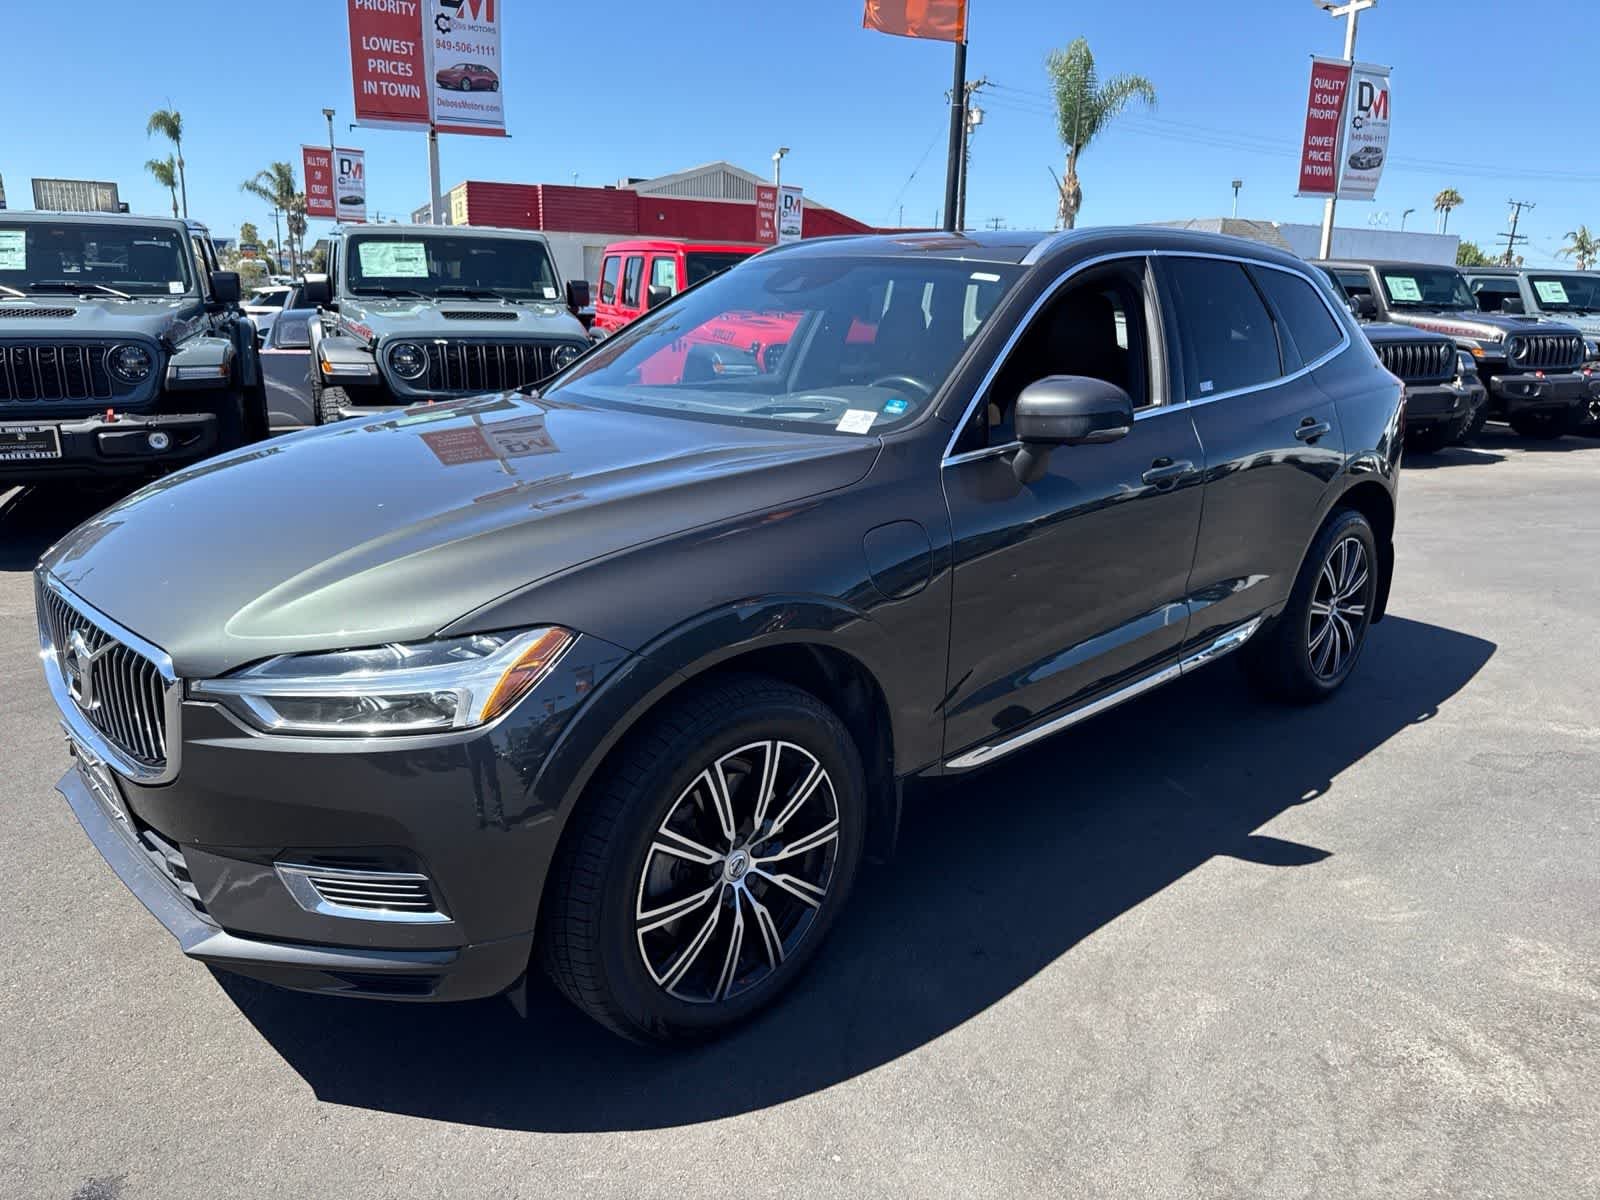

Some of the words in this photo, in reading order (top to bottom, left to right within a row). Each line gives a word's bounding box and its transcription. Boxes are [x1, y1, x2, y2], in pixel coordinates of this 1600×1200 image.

[355, 0, 416, 16] PRIORITY
[362, 36, 415, 56] LOWEST
[435, 38, 496, 57] 949-506-1111
[367, 59, 413, 77] PRICES
[363, 80, 378, 95] IN
[380, 82, 421, 99] TOWN
[1314, 78, 1345, 90] QUALITY
[1315, 94, 1322, 104] IS
